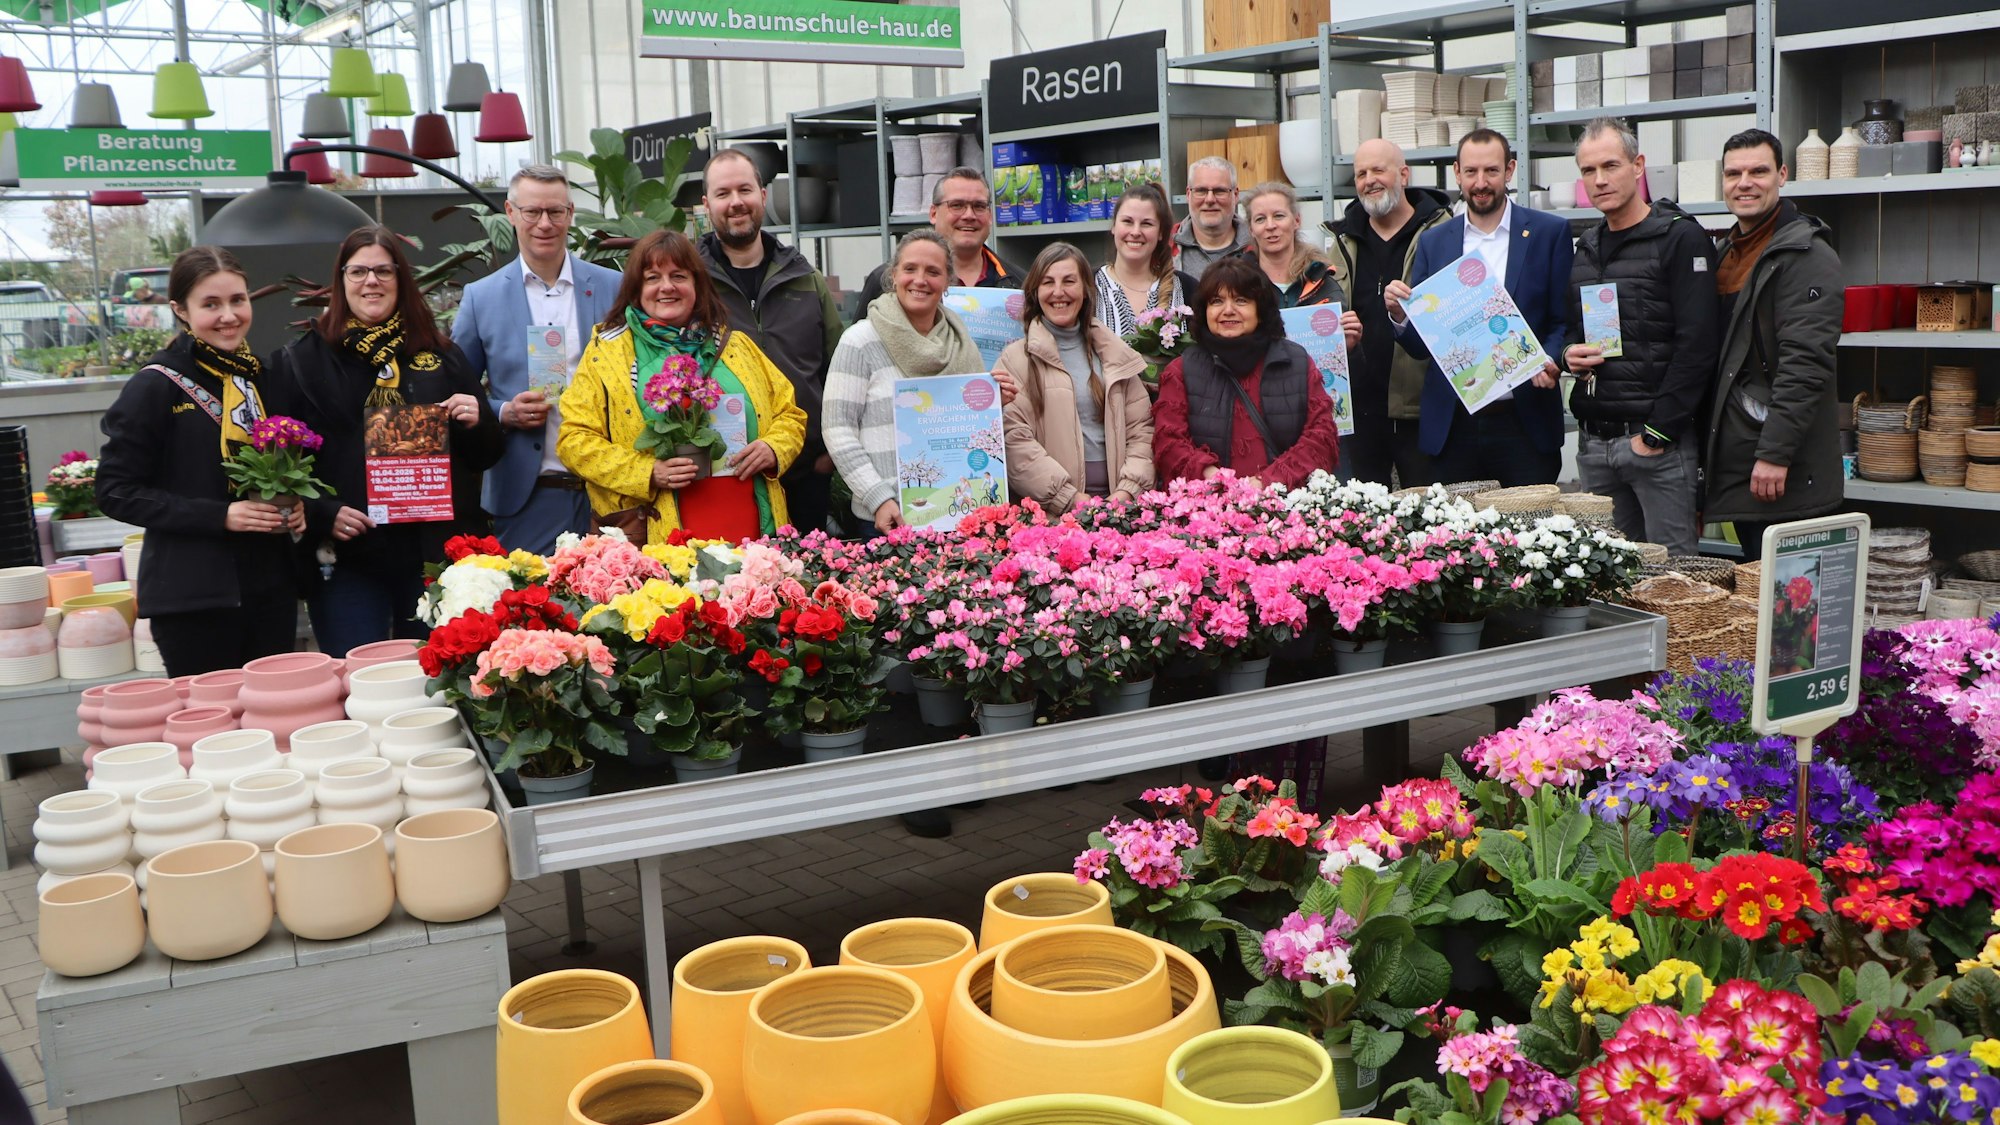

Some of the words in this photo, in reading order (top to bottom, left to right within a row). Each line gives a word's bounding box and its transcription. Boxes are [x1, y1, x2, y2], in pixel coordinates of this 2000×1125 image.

[651, 8, 953, 39] www.baumschule-hau.de
[1022, 60, 1122, 105] Rasen
[98, 133, 203, 153] Beratung
[63, 155, 237, 172] Pflanzenschutz
[104, 180, 203, 188] www.baumschule-hau.de
[917, 415, 966, 425] ERWACHEN
[968, 413, 980, 421] IM
[921, 424, 977, 435] VORGEBIRGE
[370, 476, 416, 484] 19.04.2026
[373, 484, 417, 492] Rheinhalle
[1807, 678, 1836, 700] 2,59
[1839, 674, 1848, 692] €
